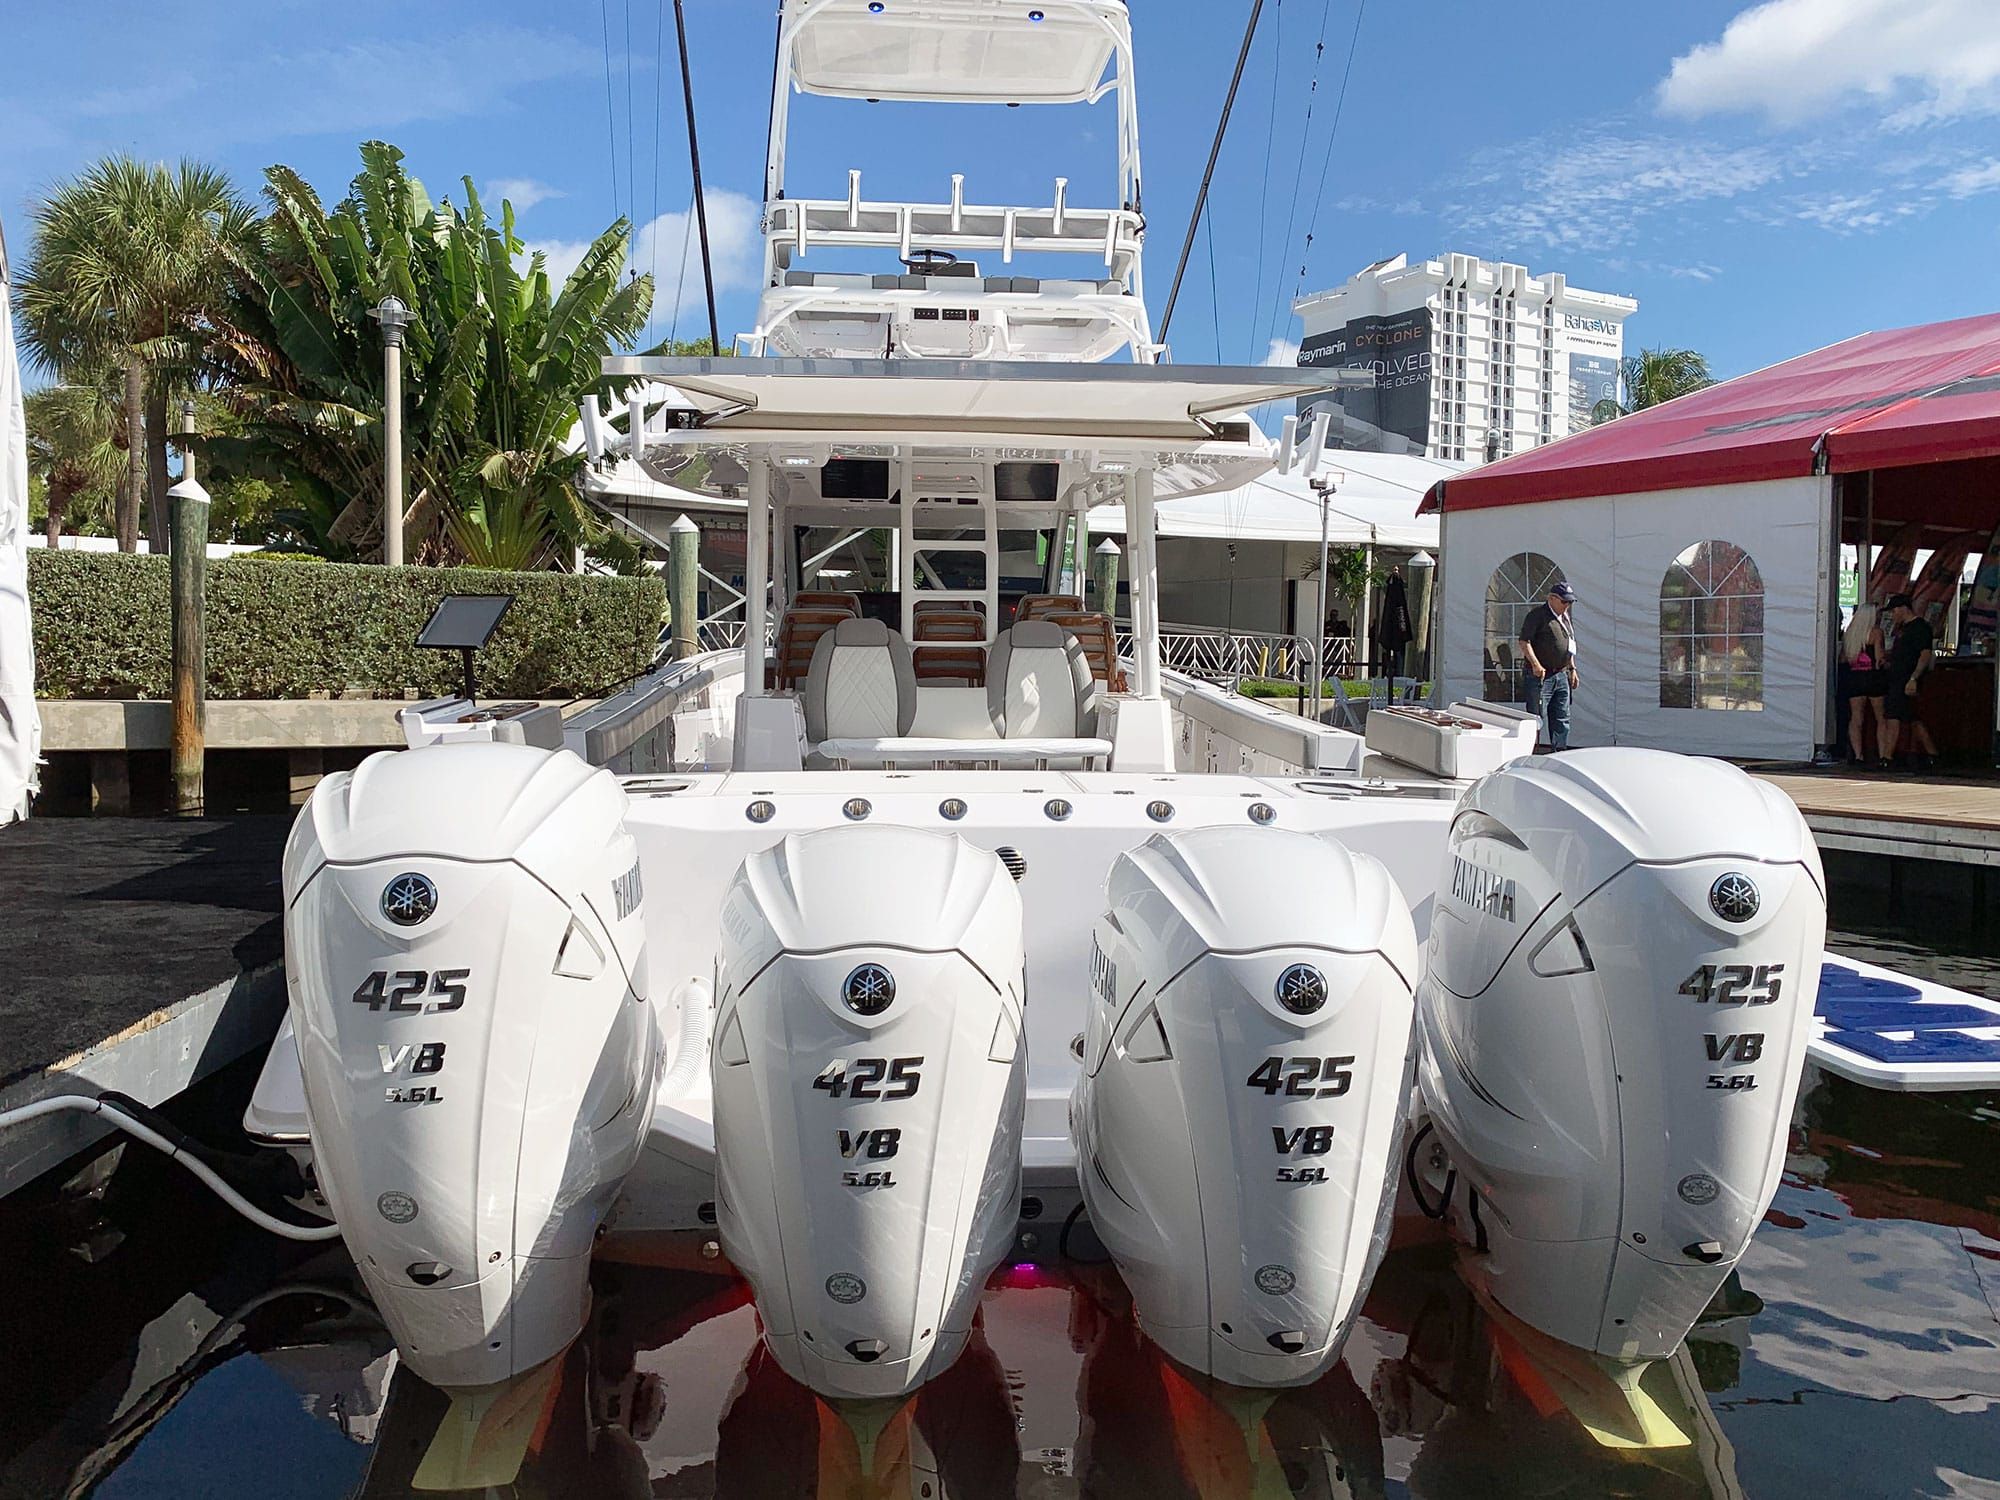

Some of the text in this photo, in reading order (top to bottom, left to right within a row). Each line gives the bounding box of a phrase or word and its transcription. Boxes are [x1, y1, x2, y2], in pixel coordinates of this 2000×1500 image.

[1355, 326, 1422, 347] CYCLONE
[1298, 340, 1346, 363] Raymarin
[1376, 372, 1431, 390] HE OCEAN
[352, 968, 470, 1014] 425
[1678, 963, 1784, 1006] 425
[377, 1042, 447, 1073] V8
[1703, 1033, 1765, 1061] V8
[812, 1056, 925, 1100] 425
[1246, 1055, 1356, 1098] 425
[1705, 1074, 1759, 1090] 5.6L
[384, 1086, 444, 1104] 5.6L
[836, 1128, 902, 1159] V8
[1271, 1126, 1335, 1155] V8
[841, 1171, 897, 1187] 5.6L
[1275, 1167, 1330, 1183] 5.6L
